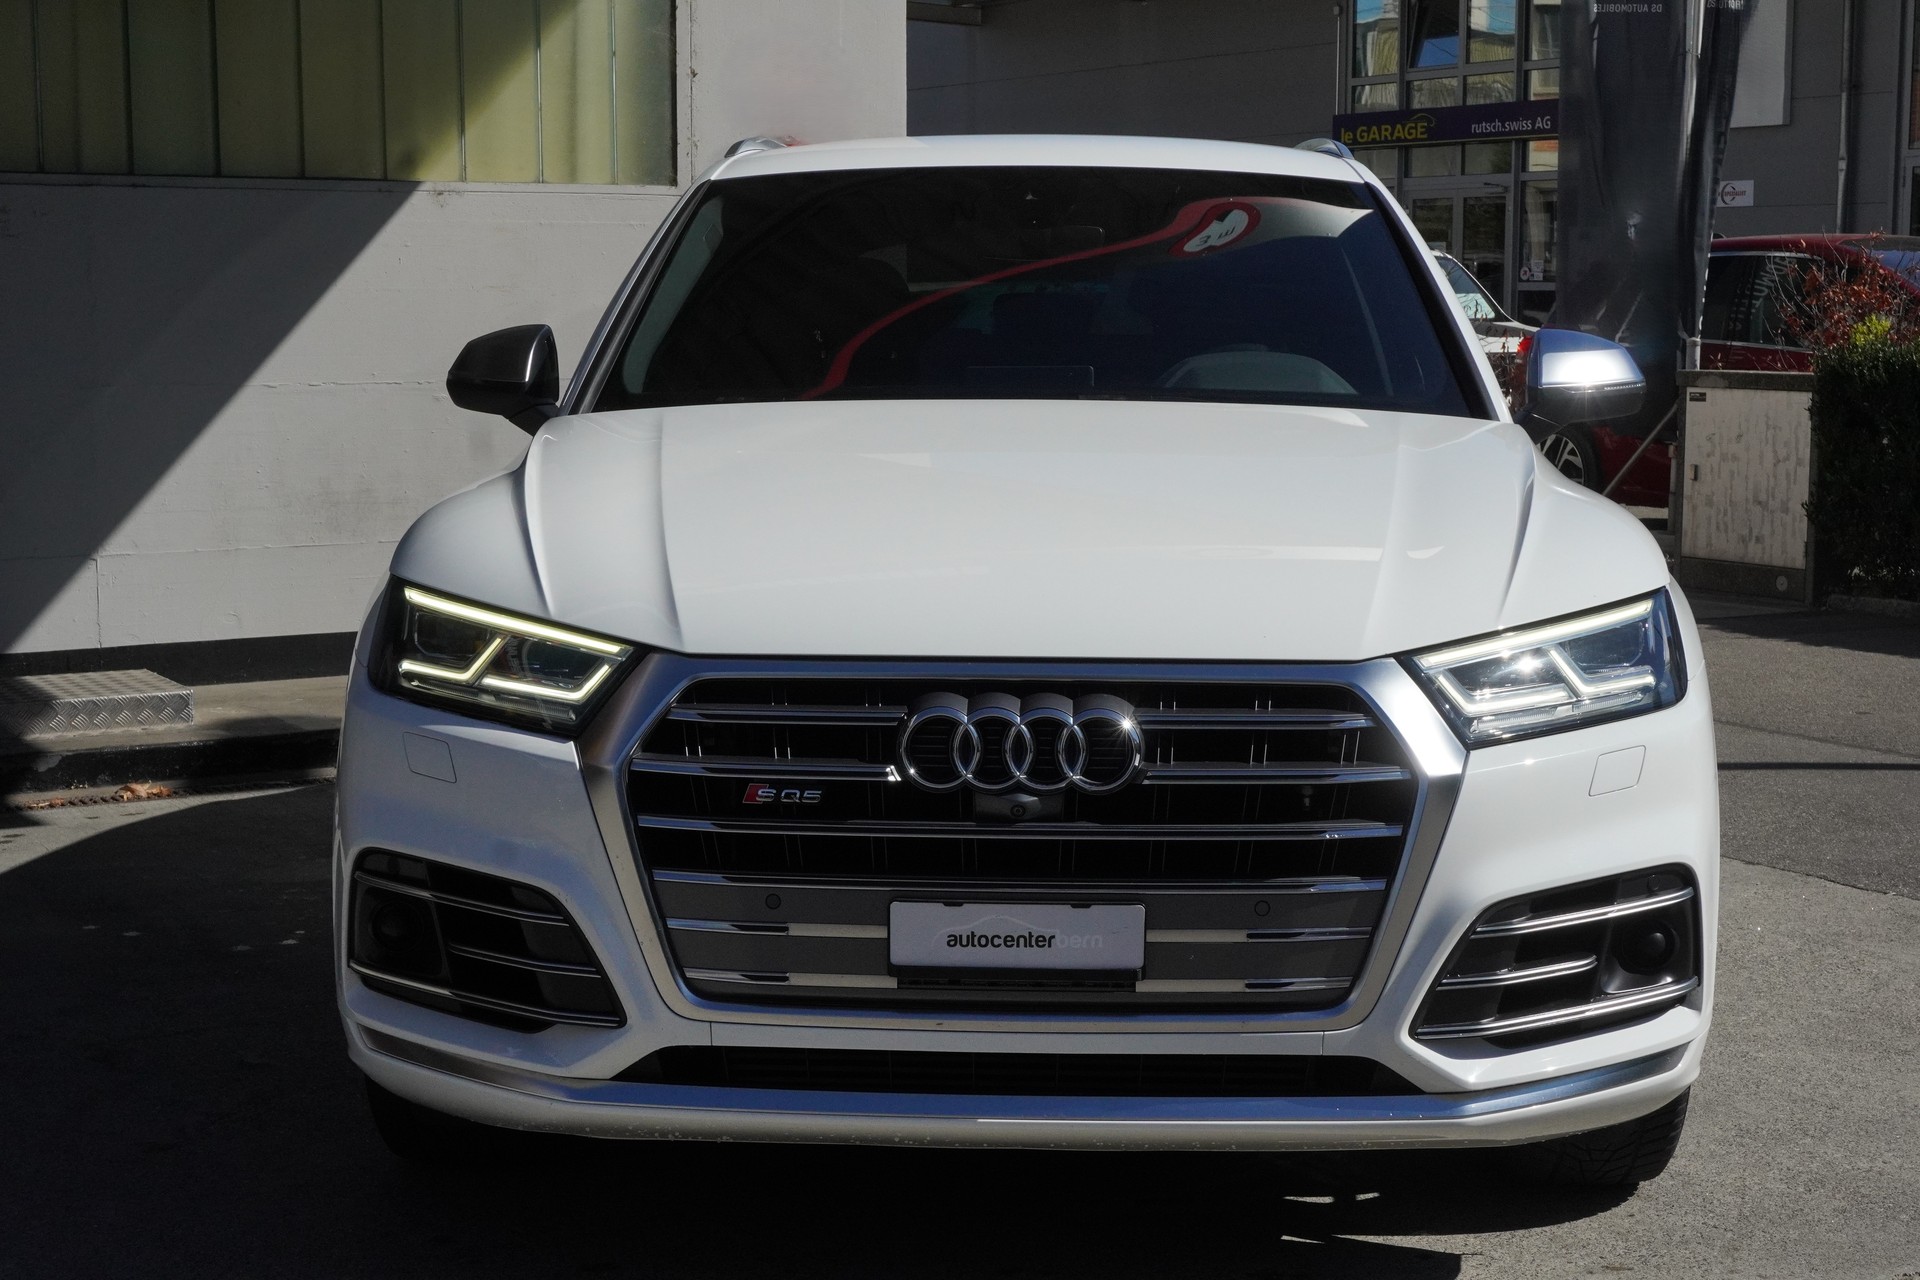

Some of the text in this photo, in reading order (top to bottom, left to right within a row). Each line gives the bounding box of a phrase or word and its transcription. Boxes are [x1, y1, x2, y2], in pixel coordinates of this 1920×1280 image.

[1341, 122, 1428, 143] le GARAGE
[1471, 115, 1551, 133] rutsch.swiss AG
[756, 788, 822, 803] SQ5
